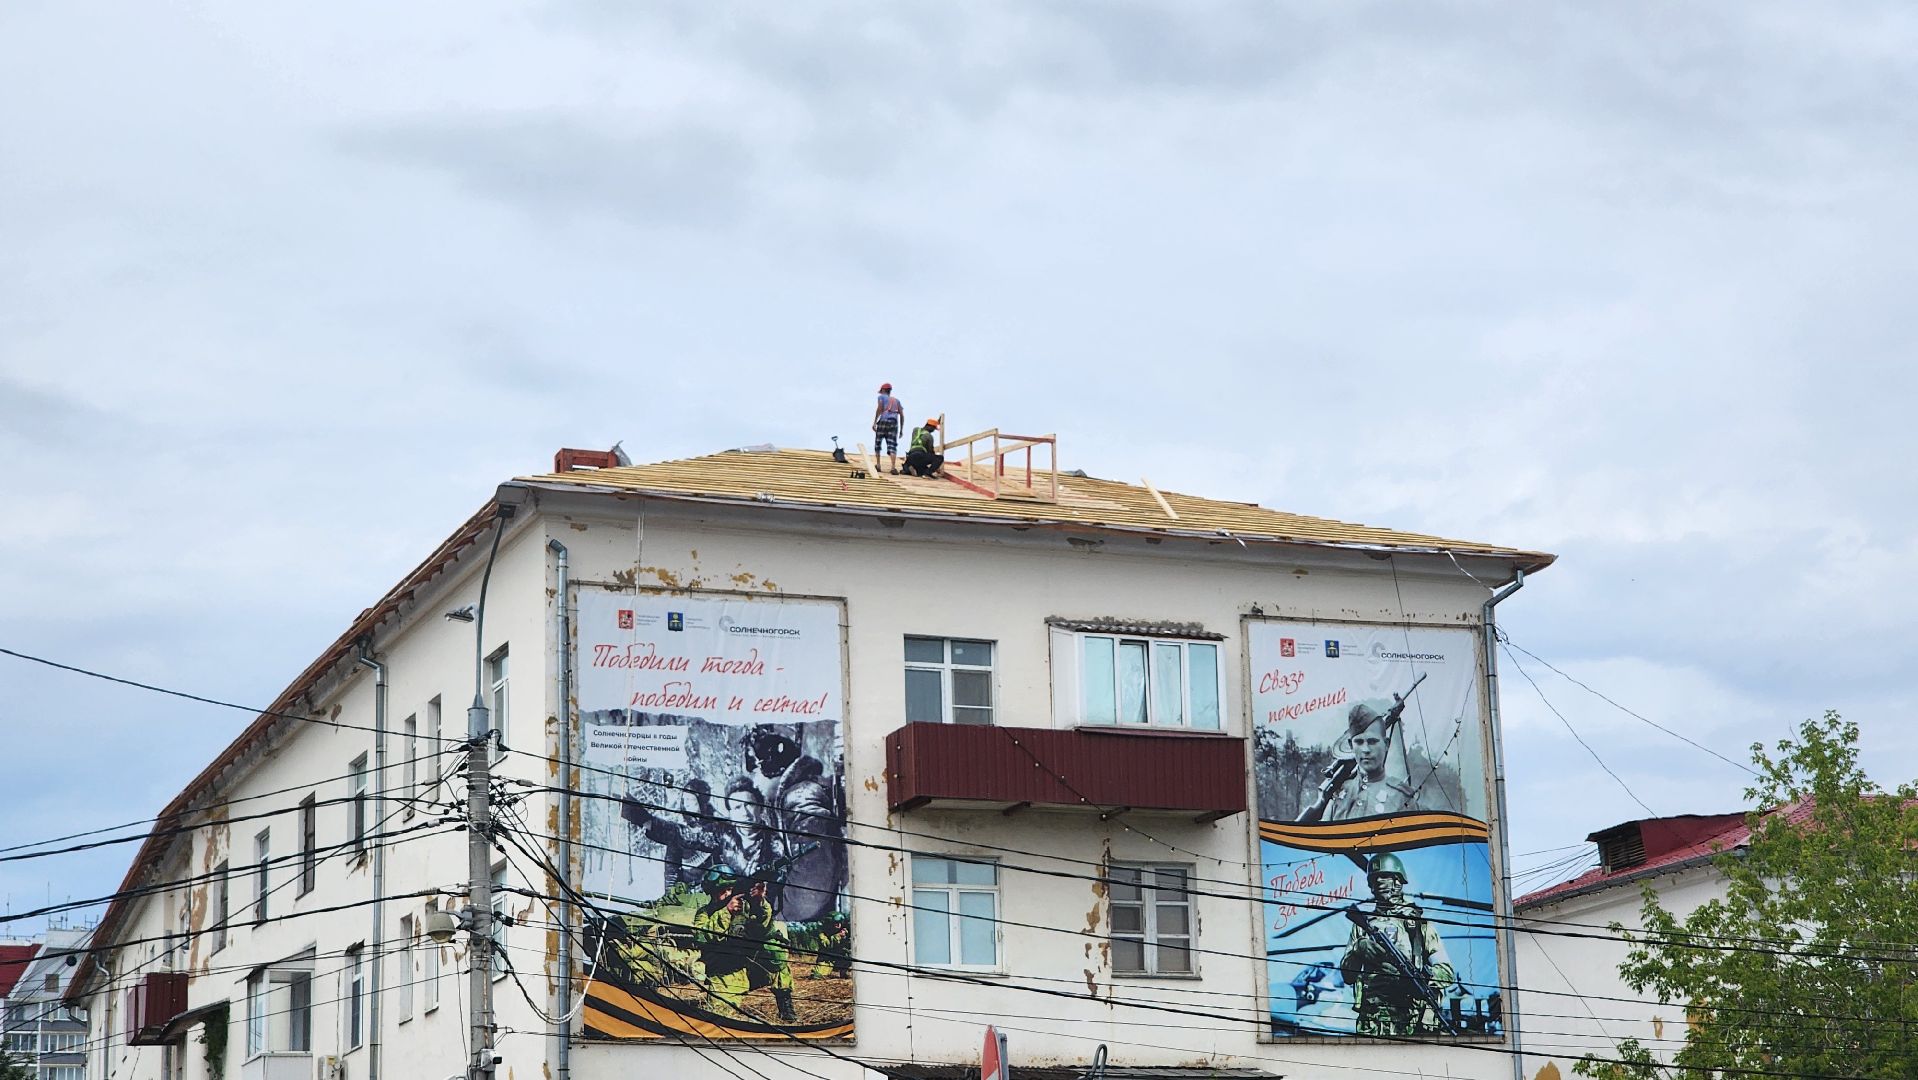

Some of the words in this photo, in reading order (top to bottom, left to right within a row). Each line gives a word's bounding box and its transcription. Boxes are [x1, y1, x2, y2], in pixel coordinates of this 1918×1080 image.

[729, 626, 800, 636] СОЛНЕЧНОГОРСК
[593, 643, 689, 671] Победили
[701, 648, 764, 675] тогда
[1380, 652, 1445, 661] СОЛНЕЧНОГОРСК
[1259, 668, 1305, 695] Связь
[631, 682, 717, 709] победим
[728, 696, 743, 710] и
[754, 692, 828, 714] сейчас!
[1268, 687, 1346, 723] поколений
[590, 741, 622, 750] Великой
[659, 733, 678, 741] годы
[1271, 861, 1324, 898] Победа
[1274, 903, 1296, 929] за
